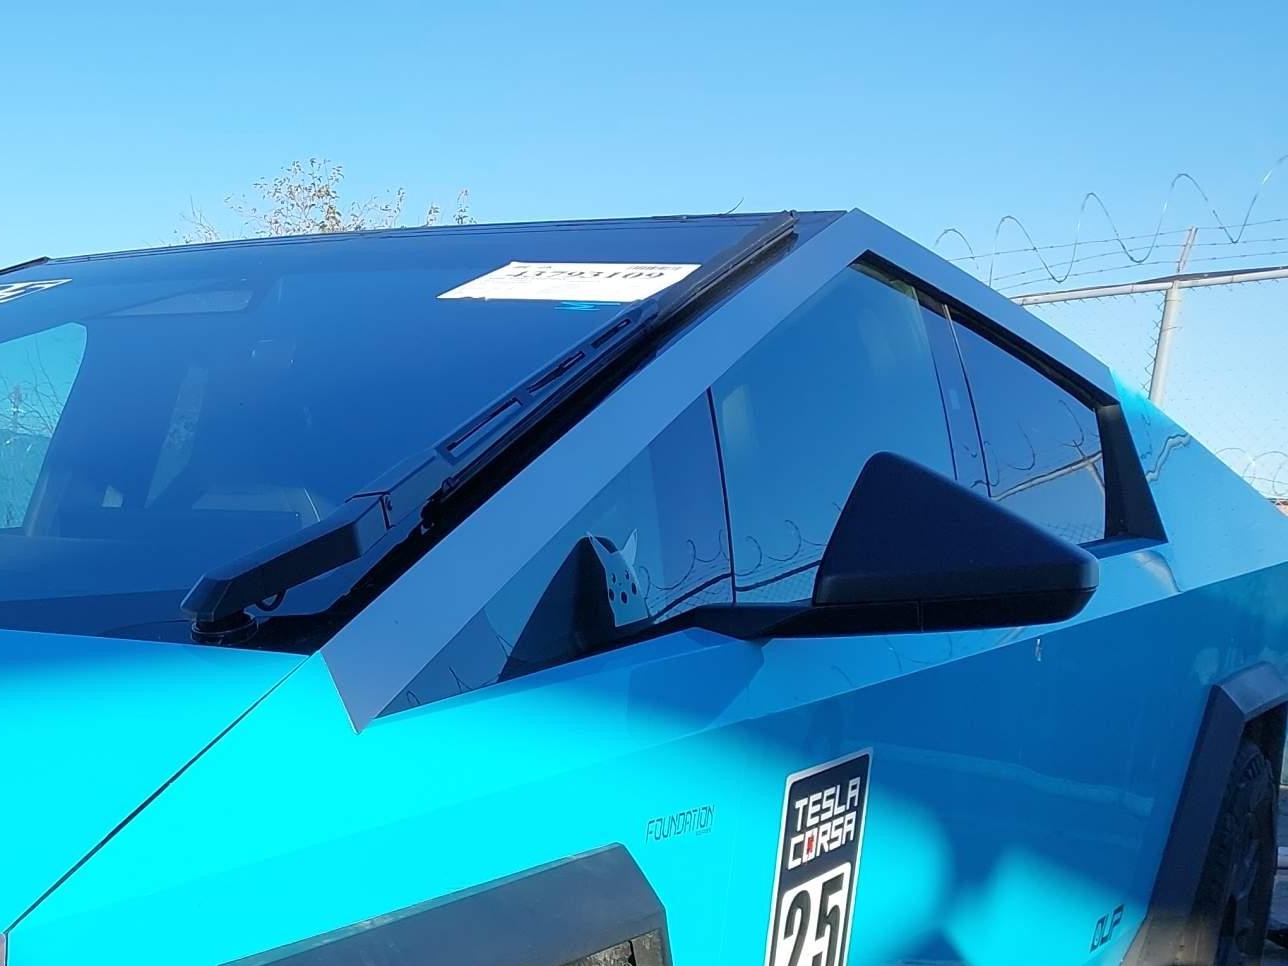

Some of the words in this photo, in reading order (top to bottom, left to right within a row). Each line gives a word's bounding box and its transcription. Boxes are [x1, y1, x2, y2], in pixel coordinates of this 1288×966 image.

[645, 804, 715, 844] FOUNDATION
[795, 776, 861, 831] TESLA
[787, 812, 856, 870] CORSA
